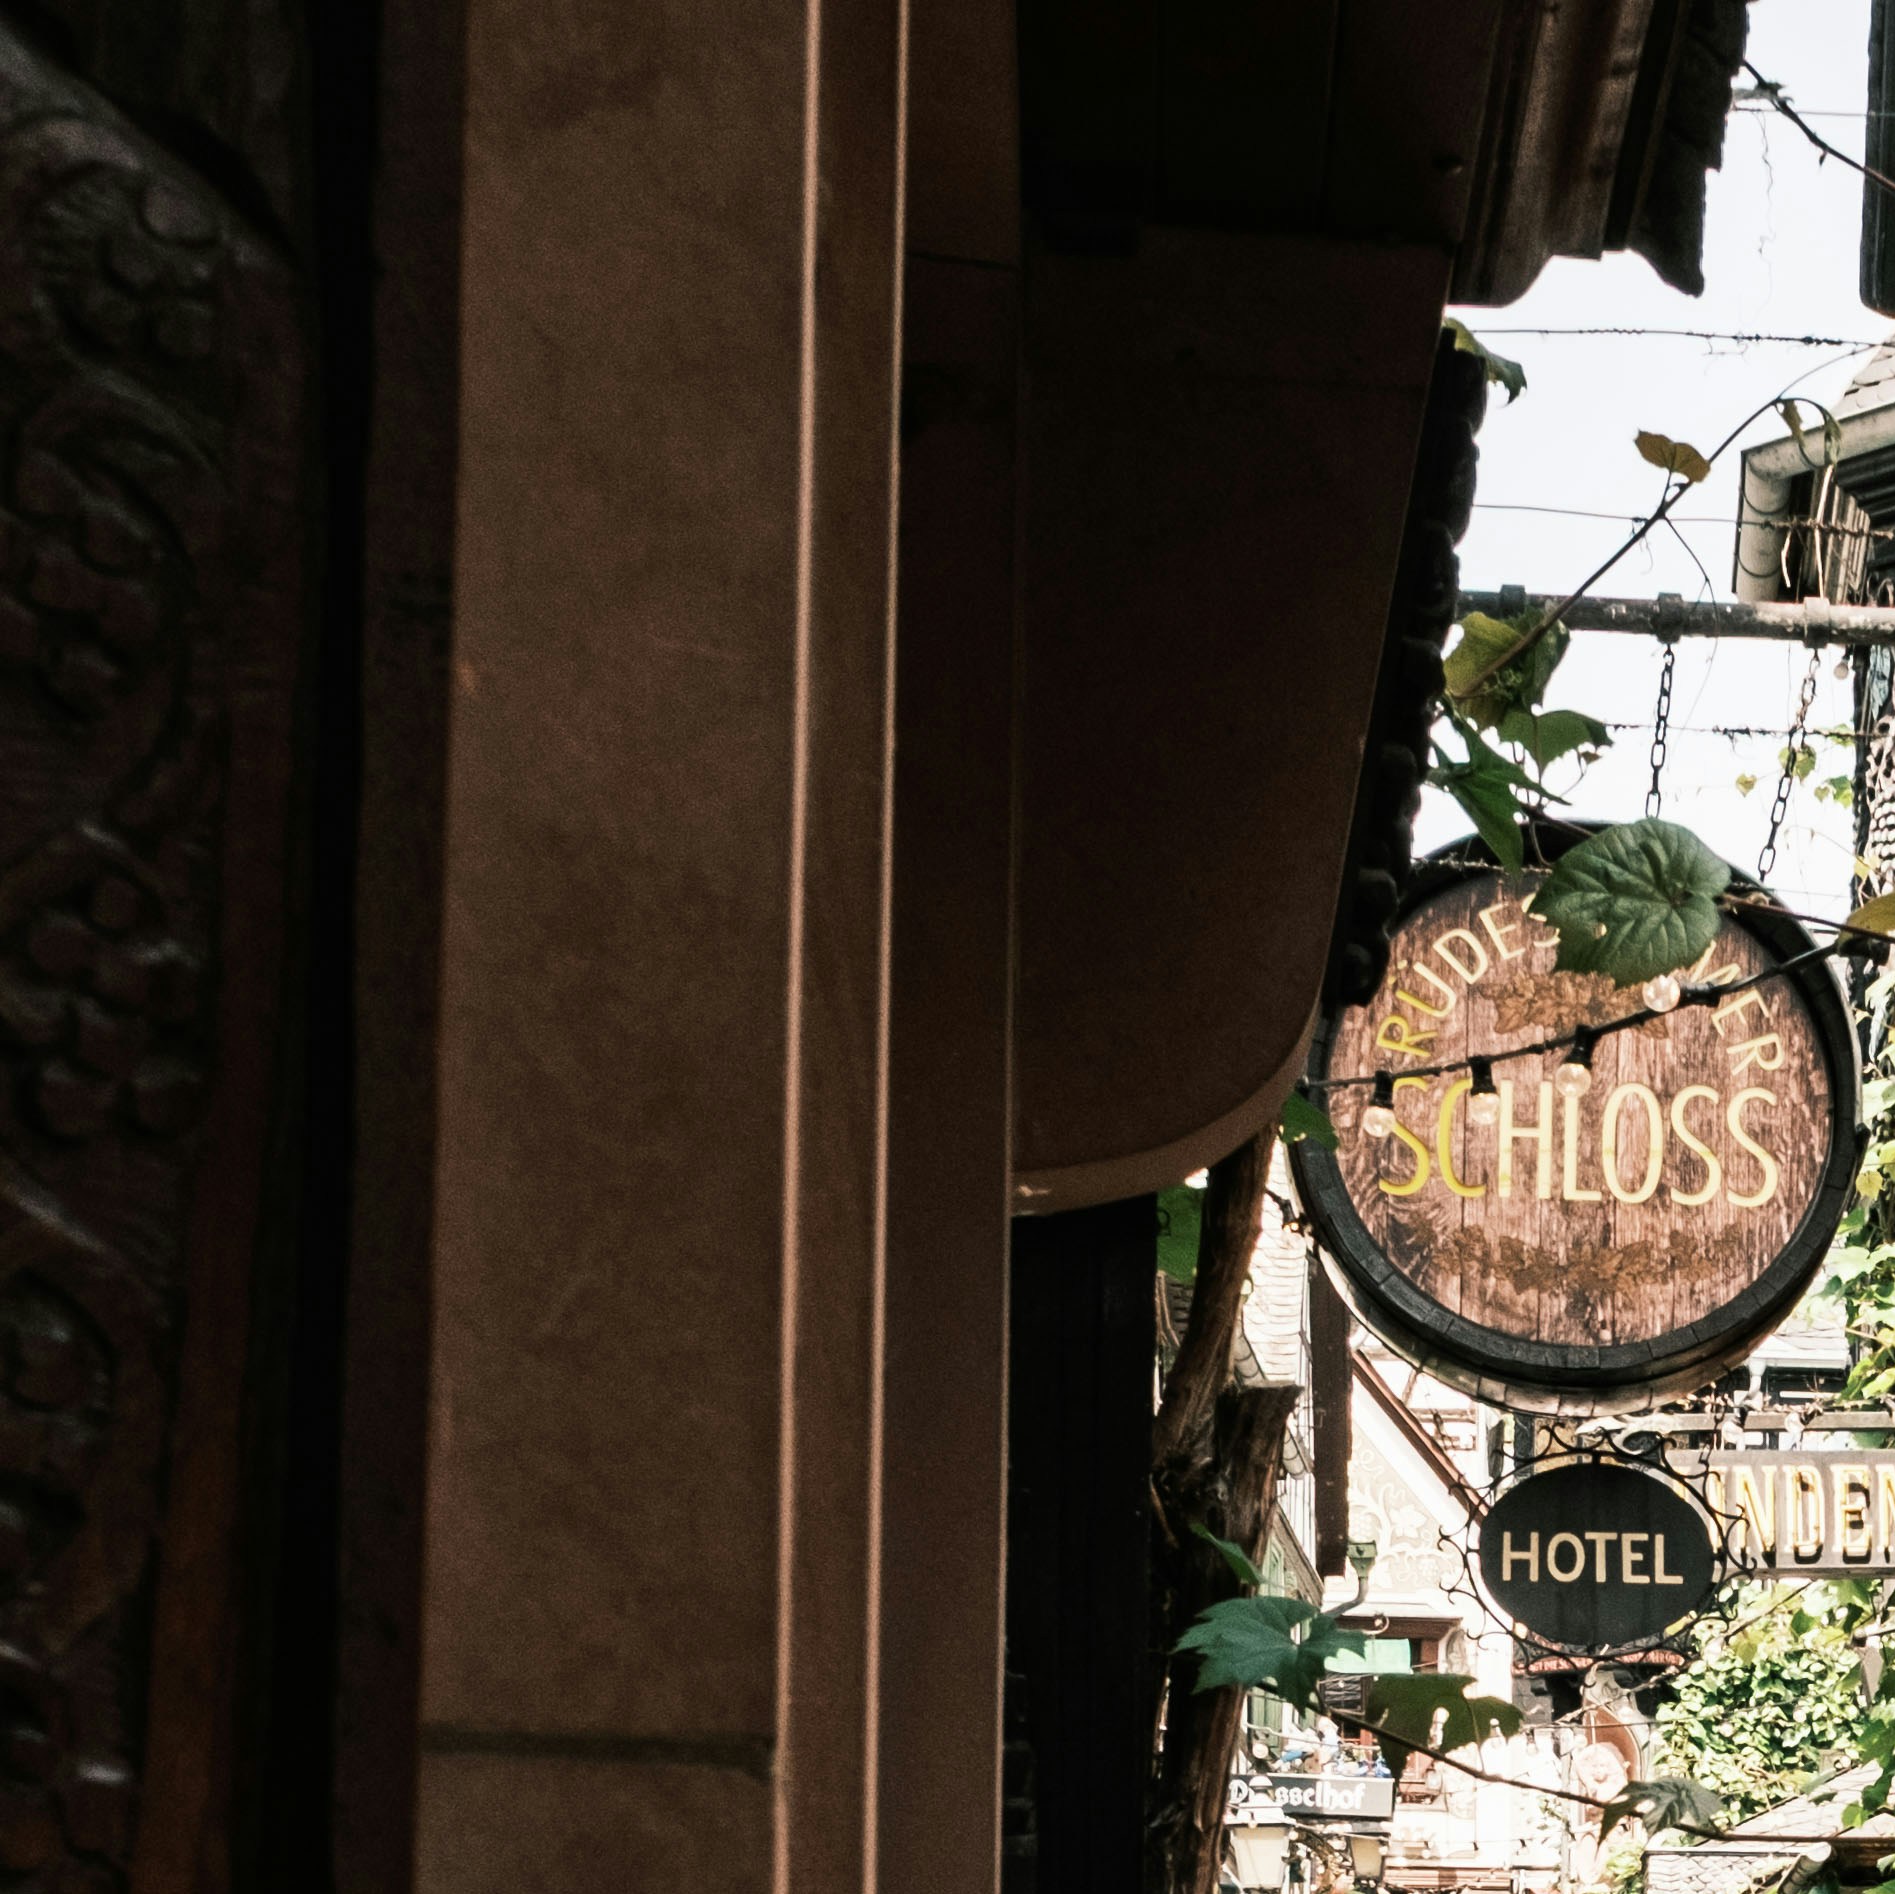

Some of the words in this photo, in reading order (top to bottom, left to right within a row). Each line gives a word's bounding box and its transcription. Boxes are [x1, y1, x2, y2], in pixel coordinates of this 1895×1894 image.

[1376, 891, 1785, 1076] RÜDESMER
[1378, 1076, 1778, 1208] SCHLOSS
[1502, 1530, 1684, 1585] HOTEL
[1229, 1779, 1367, 1810] Dsselhof
